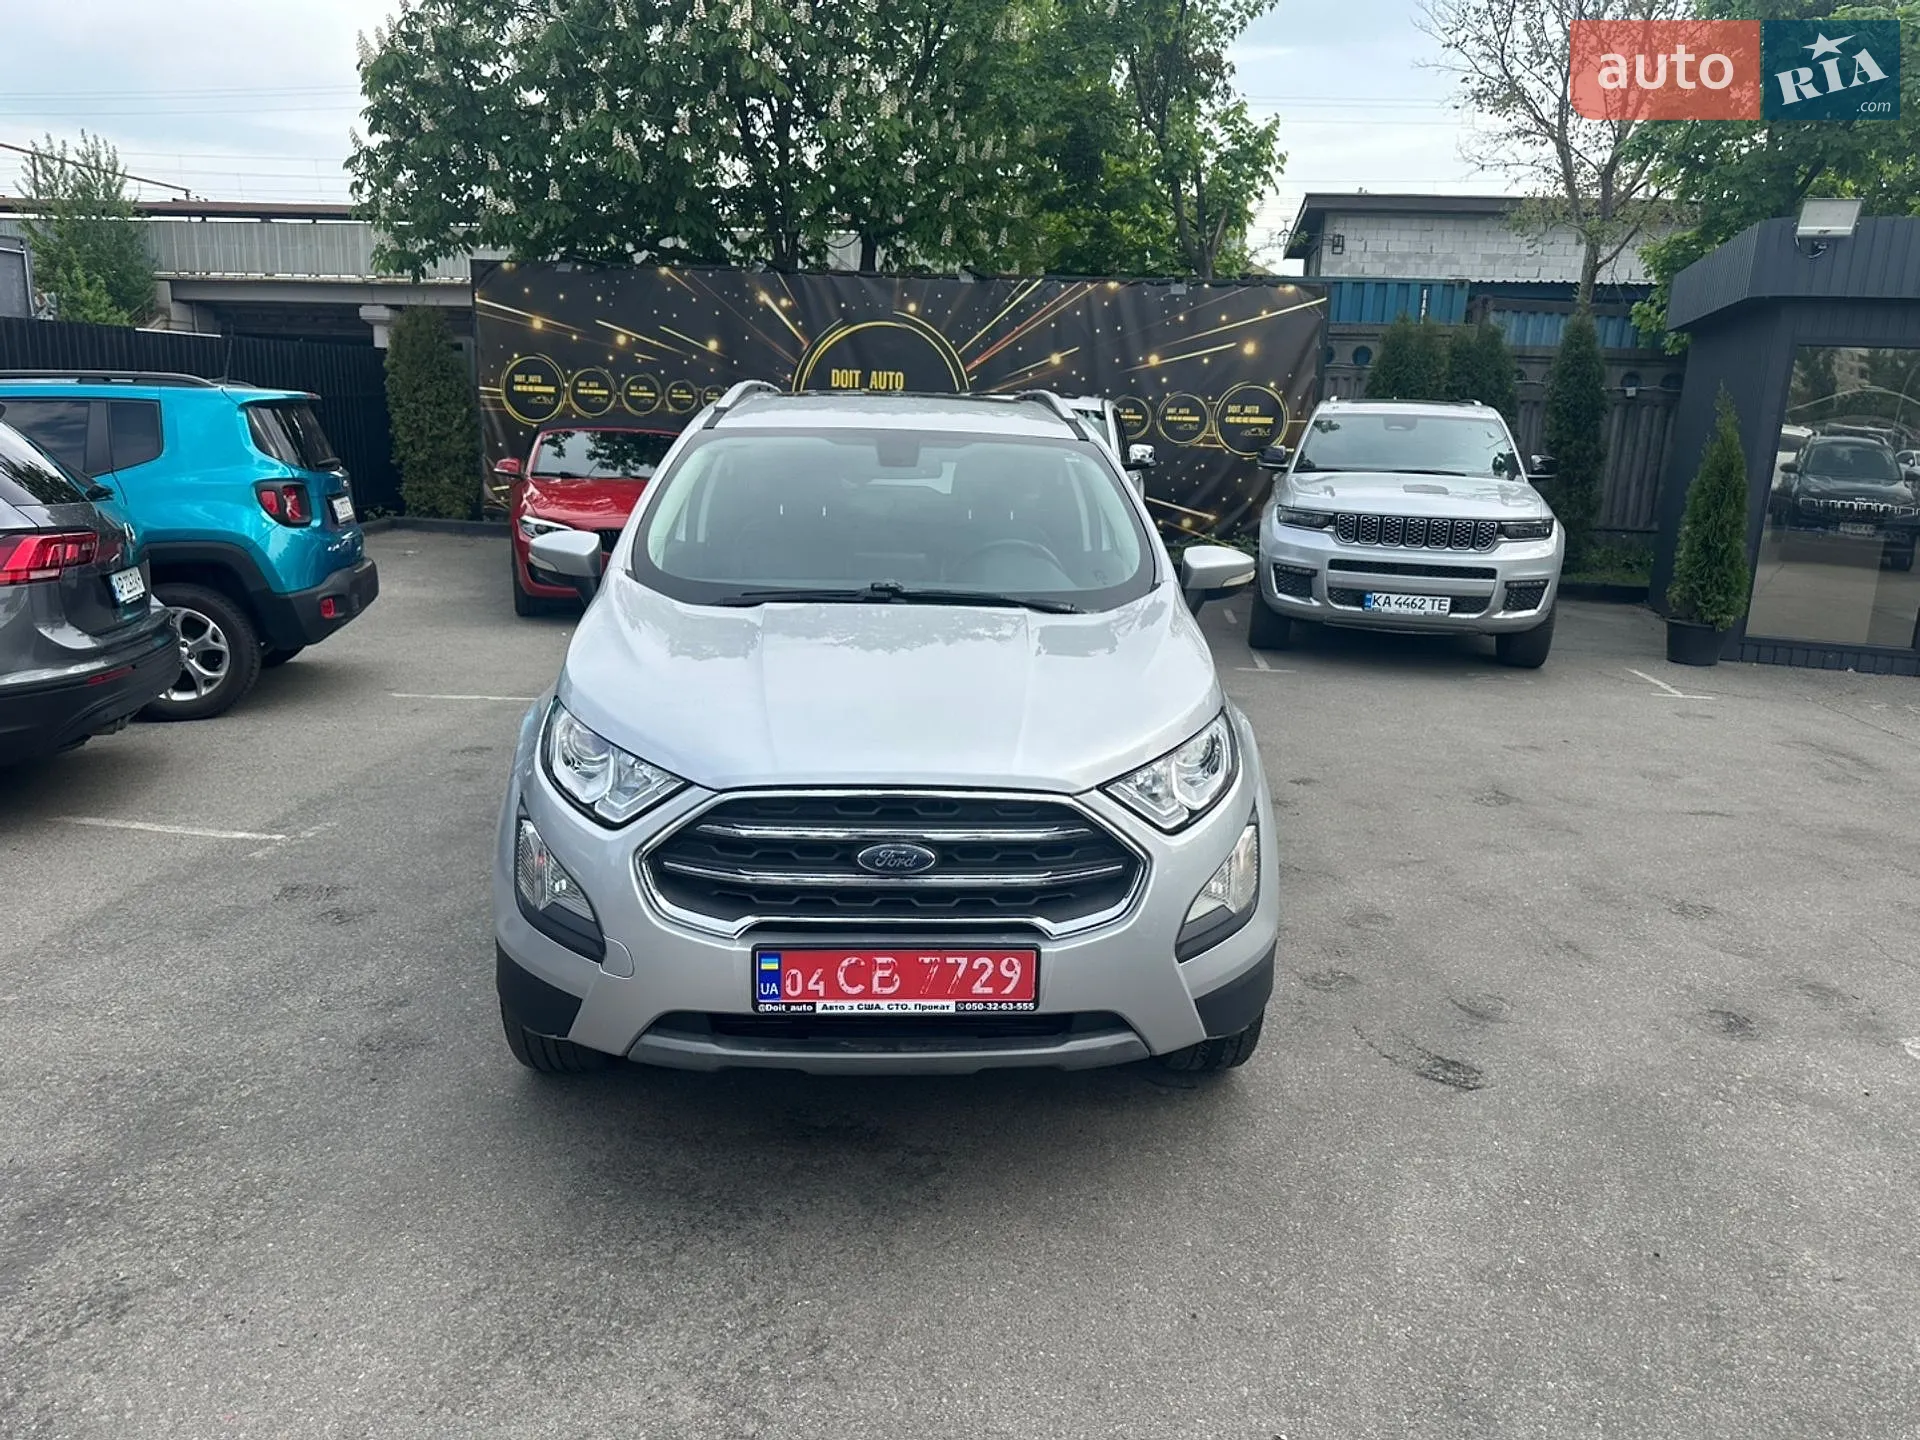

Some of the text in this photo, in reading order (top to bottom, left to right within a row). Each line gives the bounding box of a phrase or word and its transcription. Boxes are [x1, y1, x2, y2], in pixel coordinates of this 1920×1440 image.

[1372, 595, 1449, 612] KA 4462 TE
[874, 849, 916, 868] Ford
[785, 957, 1022, 997] 04 CB 7729
[760, 982, 779, 995] UA
[758, 1003, 814, 1013] @Doit_auto
[821, 1003, 845, 1011] Авто
[914, 1003, 950, 1012] Прокат
